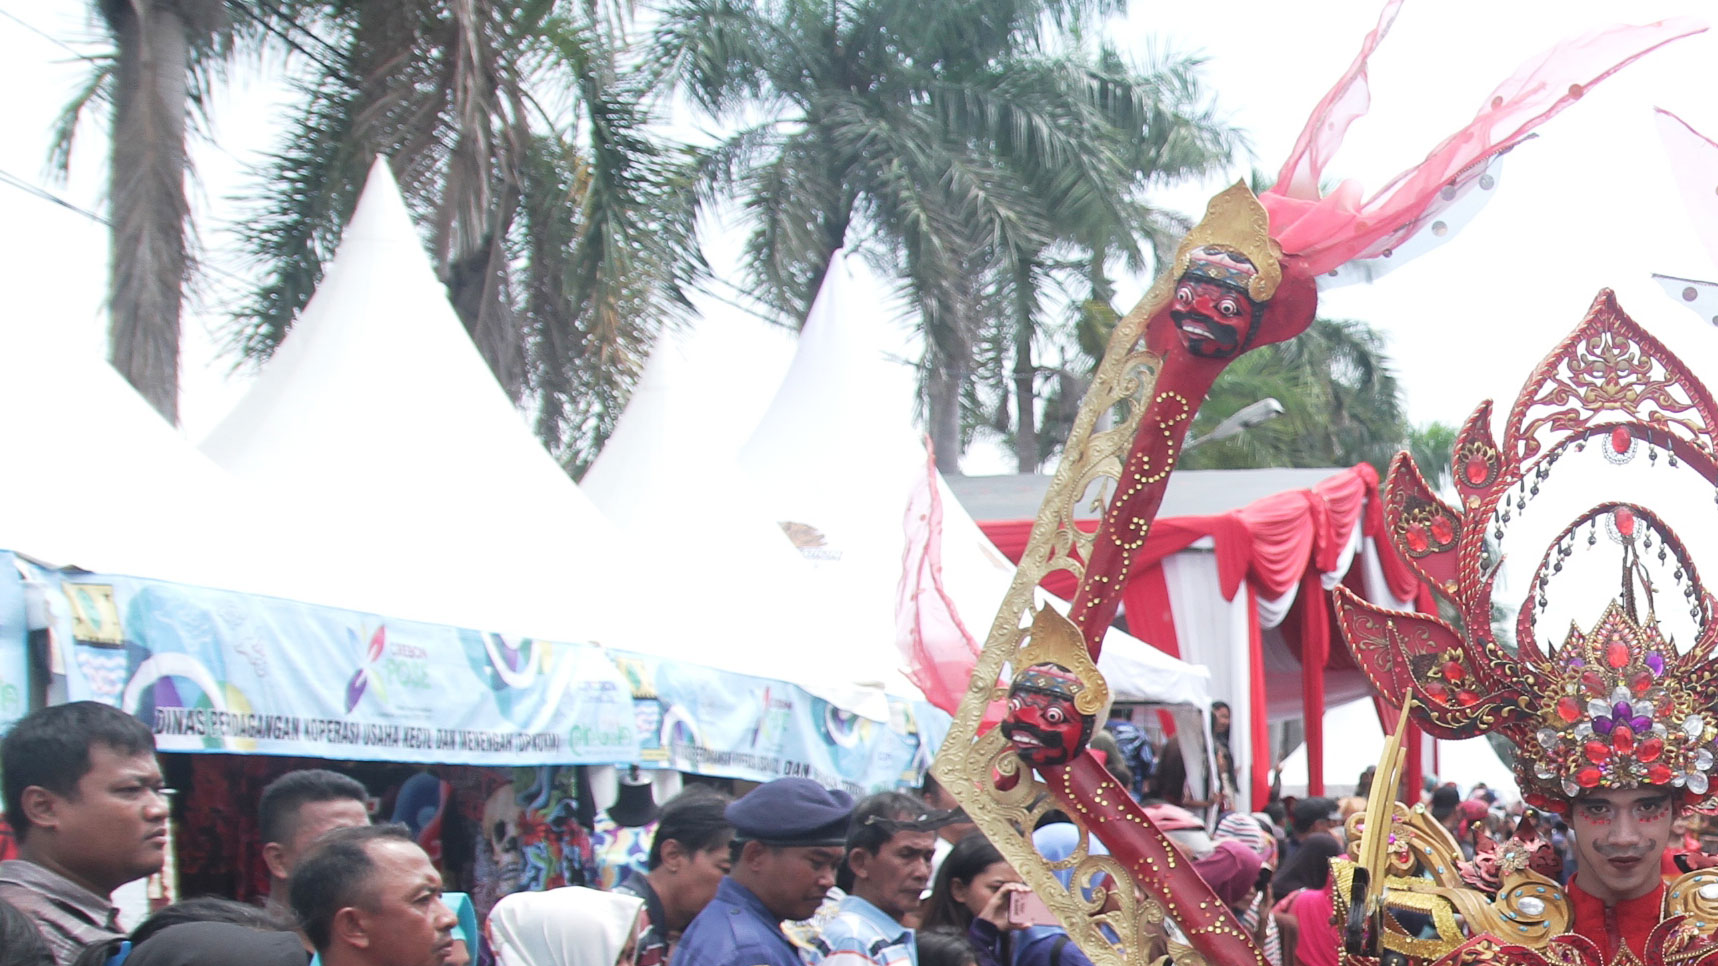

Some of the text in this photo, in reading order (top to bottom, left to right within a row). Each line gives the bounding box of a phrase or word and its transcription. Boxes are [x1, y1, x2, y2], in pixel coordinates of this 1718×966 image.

[154, 706, 205, 736] DINAS
[363, 723, 399, 747] USAHA
[402, 726, 432, 750] KECIL
[436, 728, 455, 750] DAN
[783, 760, 811, 779] DAN
